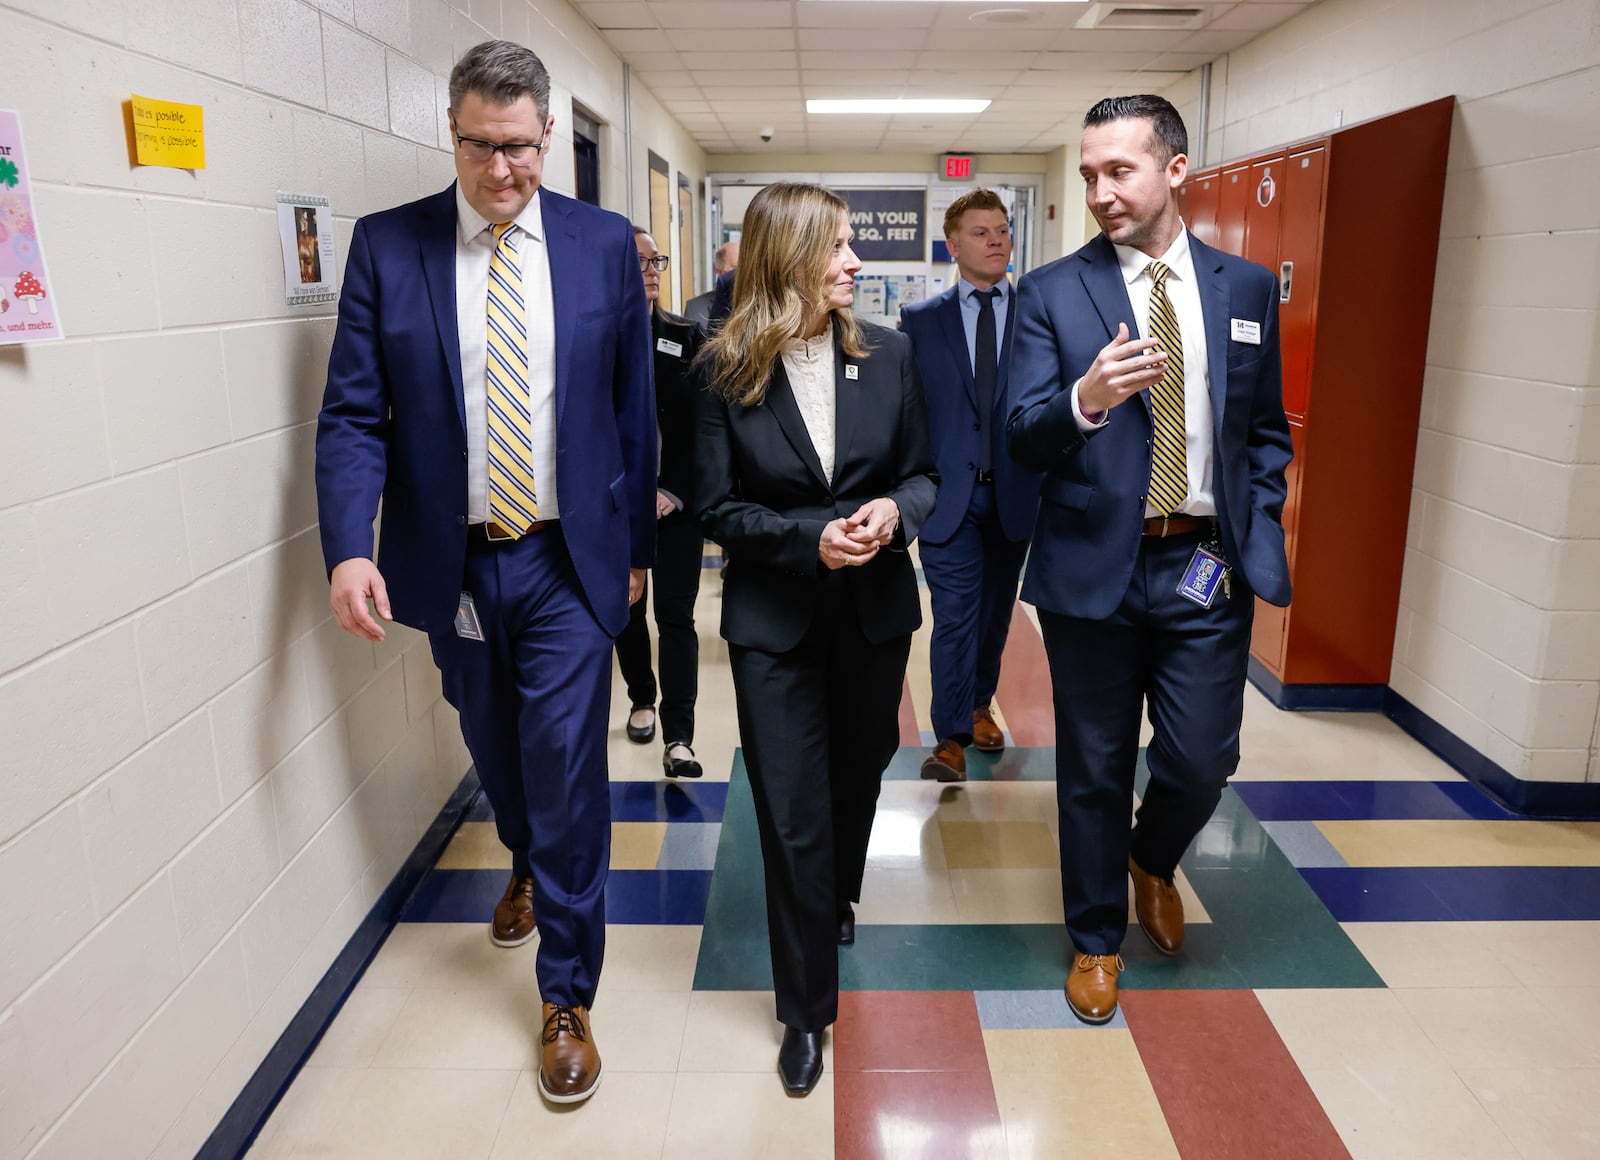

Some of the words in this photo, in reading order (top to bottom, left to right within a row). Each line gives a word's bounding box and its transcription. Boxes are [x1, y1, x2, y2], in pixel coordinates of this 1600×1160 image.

[155, 112, 186, 128] posible
[946, 157, 971, 177] EXIT
[849, 212, 873, 225] WN
[877, 211, 918, 225] YOUR
[858, 227, 883, 241] SQ.
[887, 228, 917, 241] FEET
[8, 321, 25, 332] und
